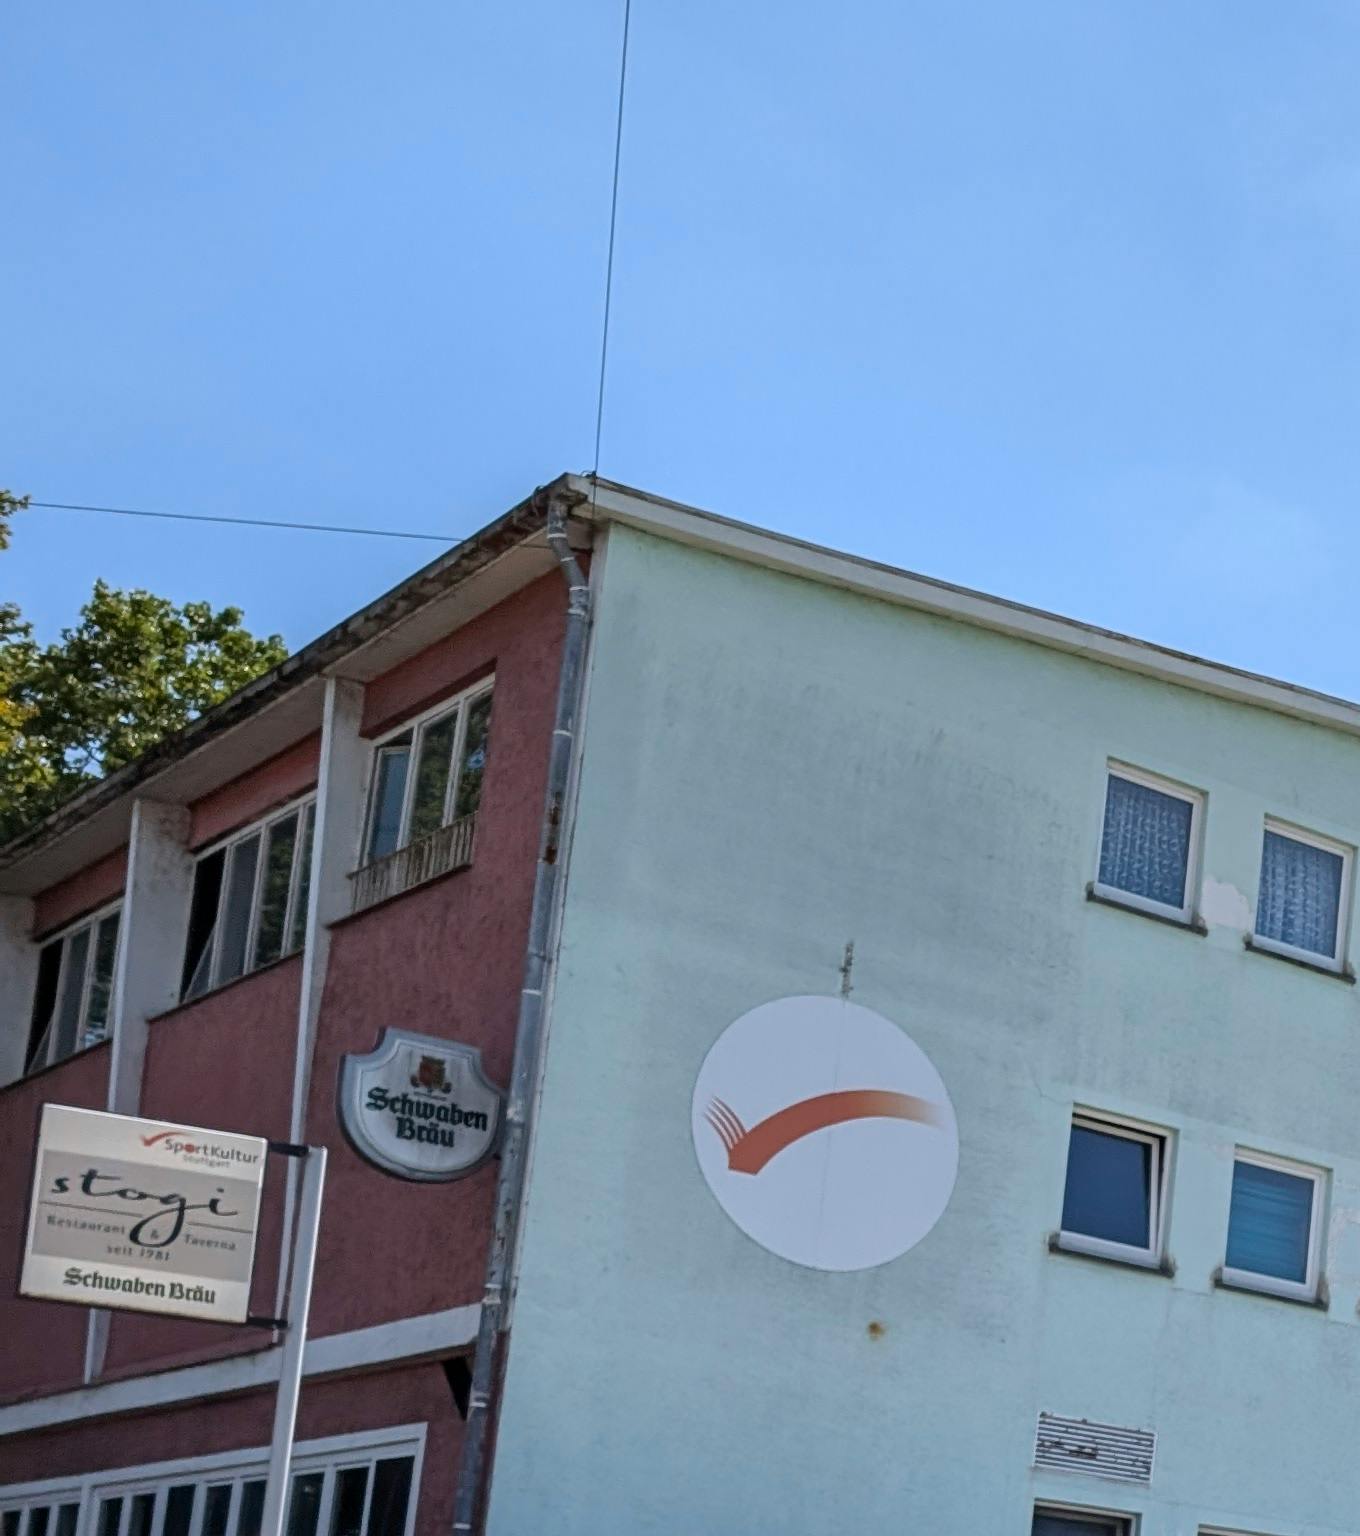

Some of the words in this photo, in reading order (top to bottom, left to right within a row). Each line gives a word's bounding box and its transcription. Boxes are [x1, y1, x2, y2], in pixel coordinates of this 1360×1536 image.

[366, 1087, 488, 1132] Schwaben
[396, 1116, 455, 1148] Bräu
[164, 1138, 259, 1164] SportKultur
[47, 1215, 126, 1235] Restaurant
[63, 1267, 166, 1298] Schwaben
[168, 1281, 216, 1304] Bräu
